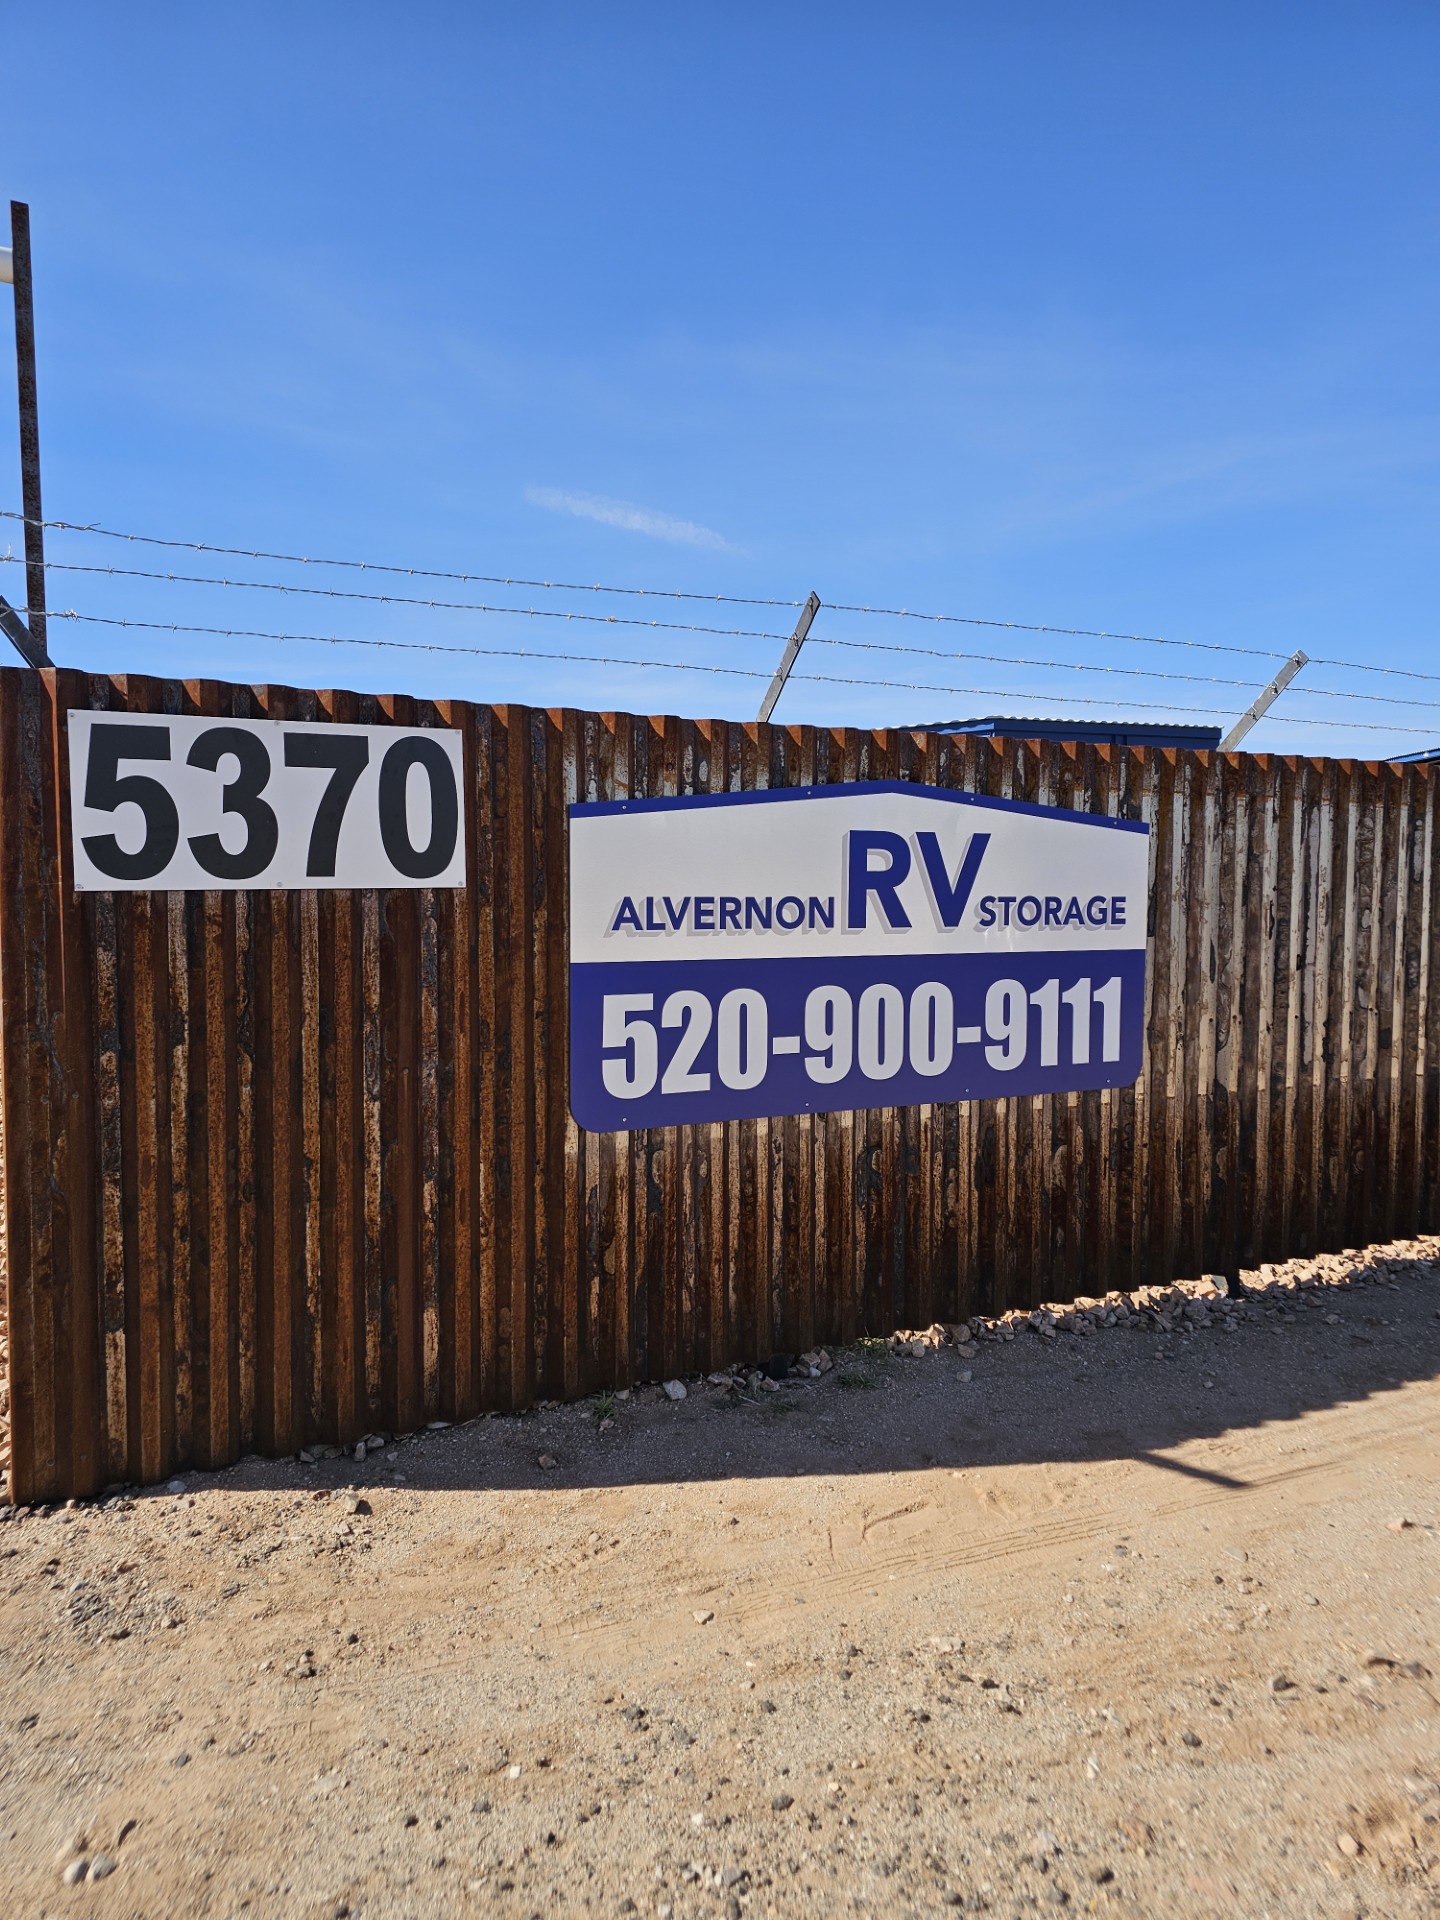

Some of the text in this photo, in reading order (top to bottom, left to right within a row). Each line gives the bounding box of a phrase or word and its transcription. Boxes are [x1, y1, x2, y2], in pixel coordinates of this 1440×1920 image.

[81, 723, 459, 880] 5370
[612, 829, 1126, 931] ALVERNON RV STORAGE
[601, 976, 1122, 1100] 520-900-9111
